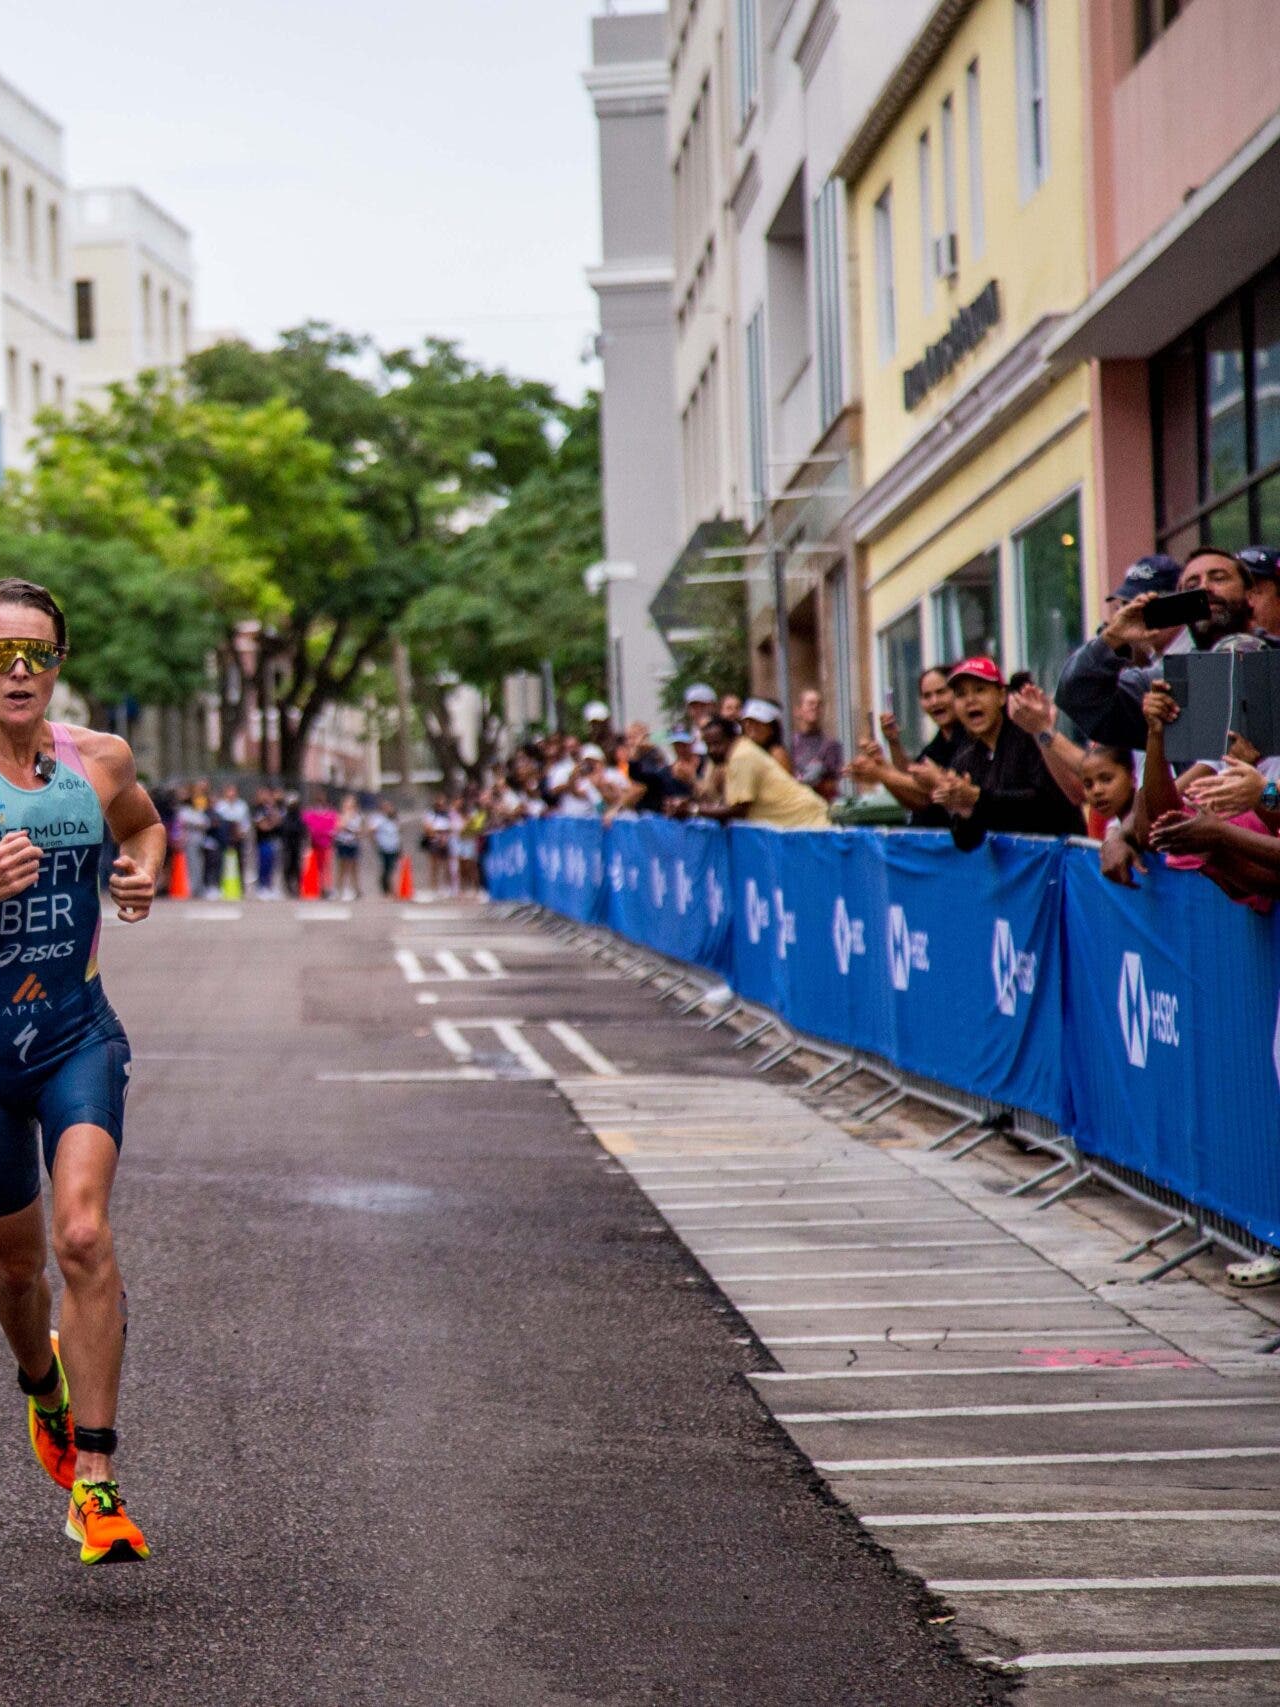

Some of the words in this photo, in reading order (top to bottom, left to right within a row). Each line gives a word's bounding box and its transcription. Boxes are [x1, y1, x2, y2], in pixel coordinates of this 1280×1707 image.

[32, 848, 90, 889] FFY
[0, 893, 75, 935] BER
[20, 940, 76, 963] asics
[2, 1000, 53, 1016] APEX
[1151, 990, 1180, 1048] HSBC
